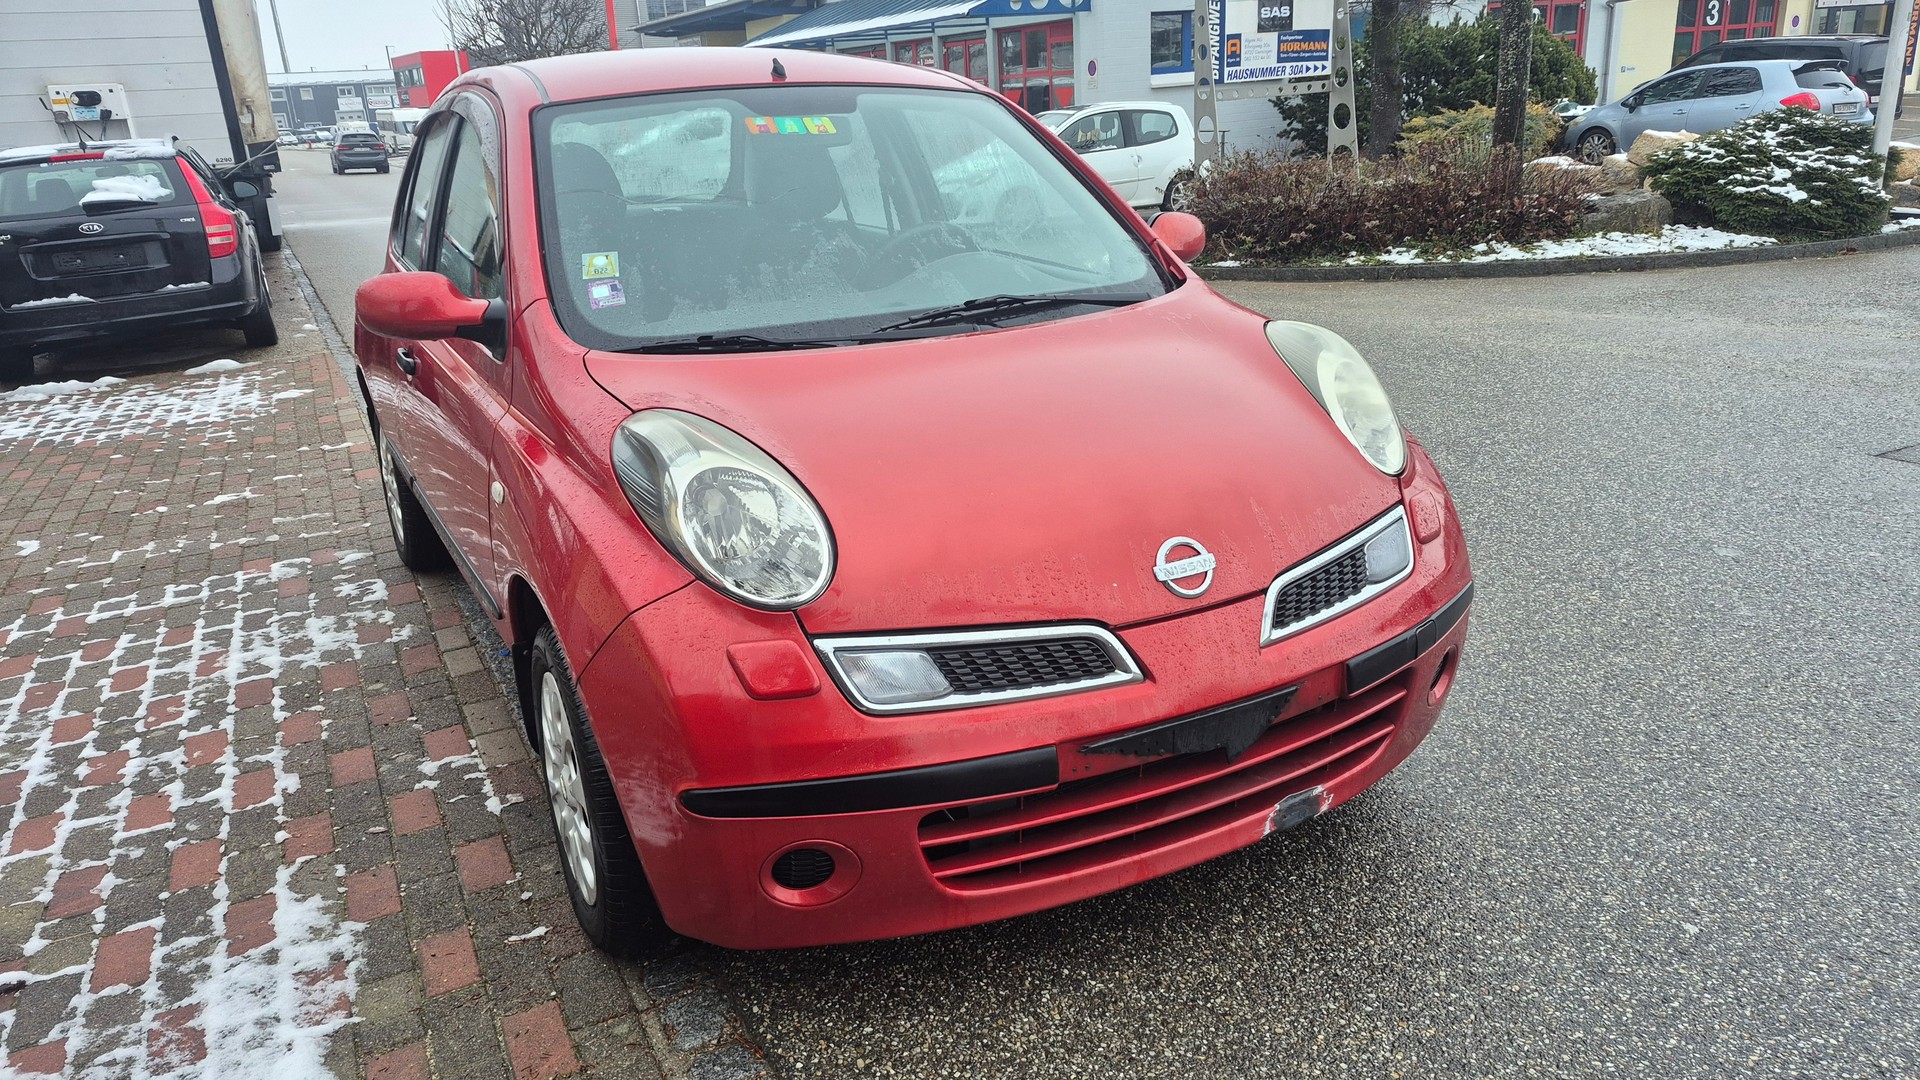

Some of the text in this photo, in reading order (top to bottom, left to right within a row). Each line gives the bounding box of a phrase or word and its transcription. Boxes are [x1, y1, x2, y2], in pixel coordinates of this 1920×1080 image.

[1260, 6, 1291, 18] SAS
[1706, 0, 1720, 26] 3
[1227, 39, 1241, 56] A
[1227, 64, 1304, 81] HAUSNUMMER 30A
[82, 224, 100, 232] KIA
[1162, 557, 1212, 579] NISSAN
